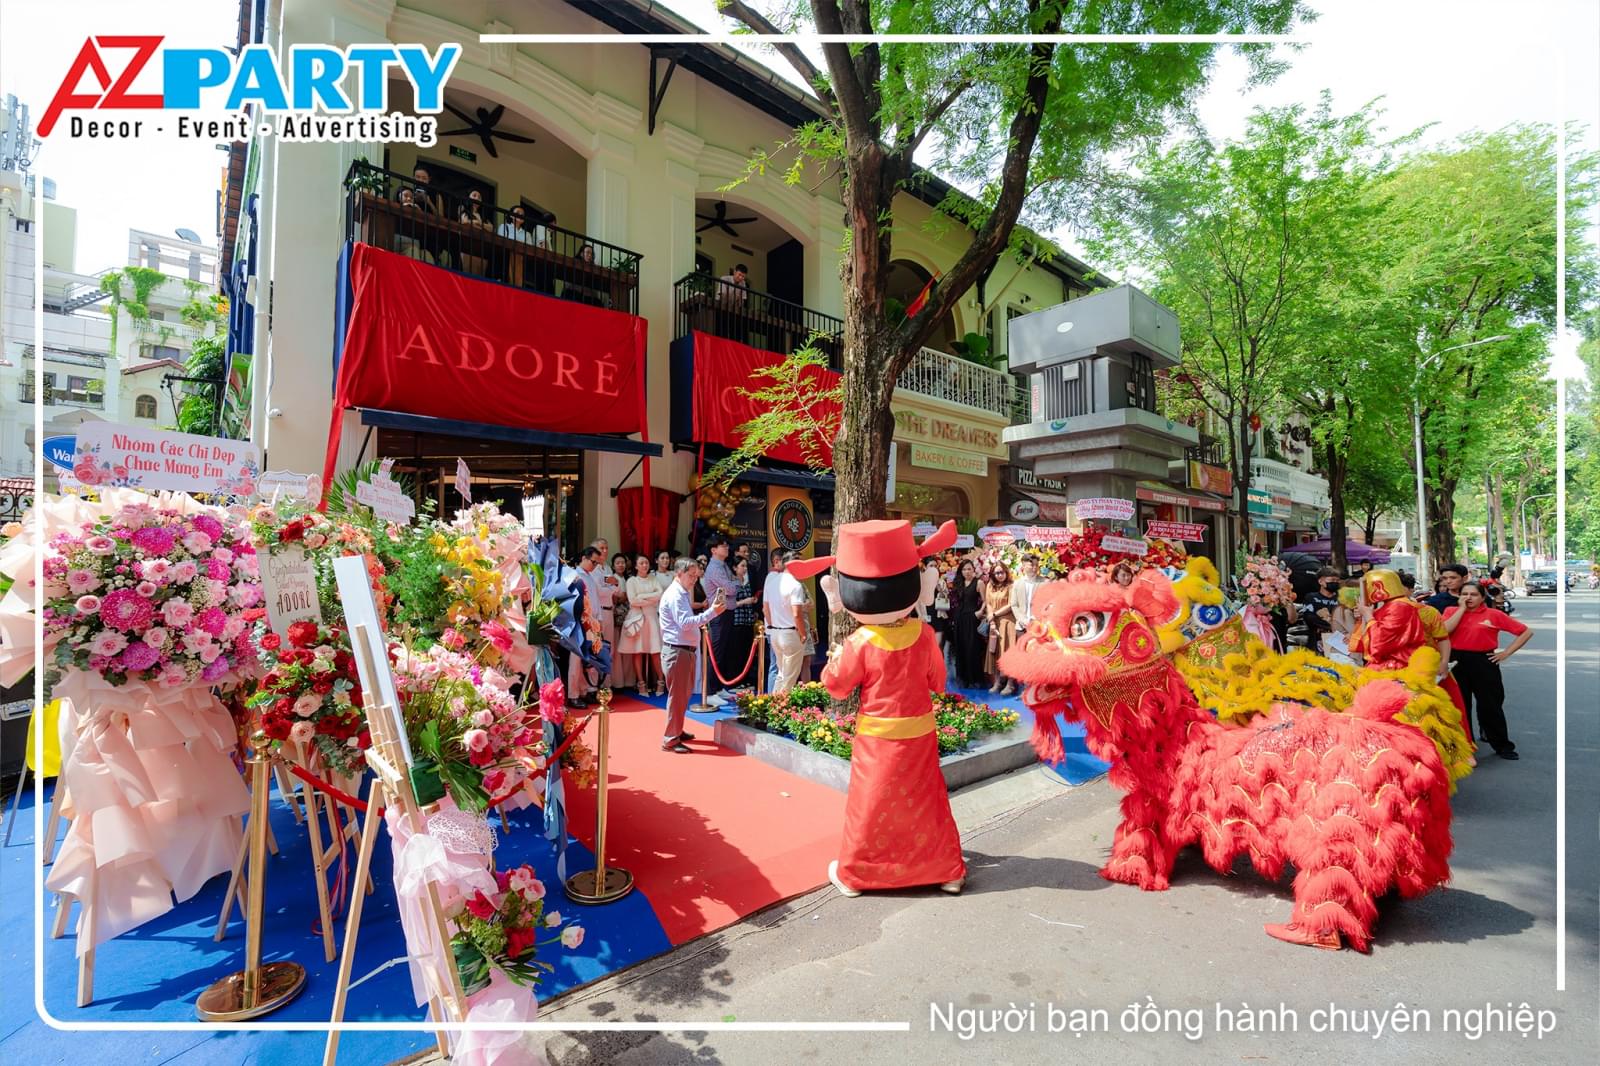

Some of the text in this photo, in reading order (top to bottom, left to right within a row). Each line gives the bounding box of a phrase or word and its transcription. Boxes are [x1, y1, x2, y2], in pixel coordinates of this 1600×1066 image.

[396, 324, 620, 398] ADORÉ
[915, 450, 945, 466] BAKERY
[956, 457, 985, 473] COFFEE
[1018, 469, 1038, 487] PIZZA
